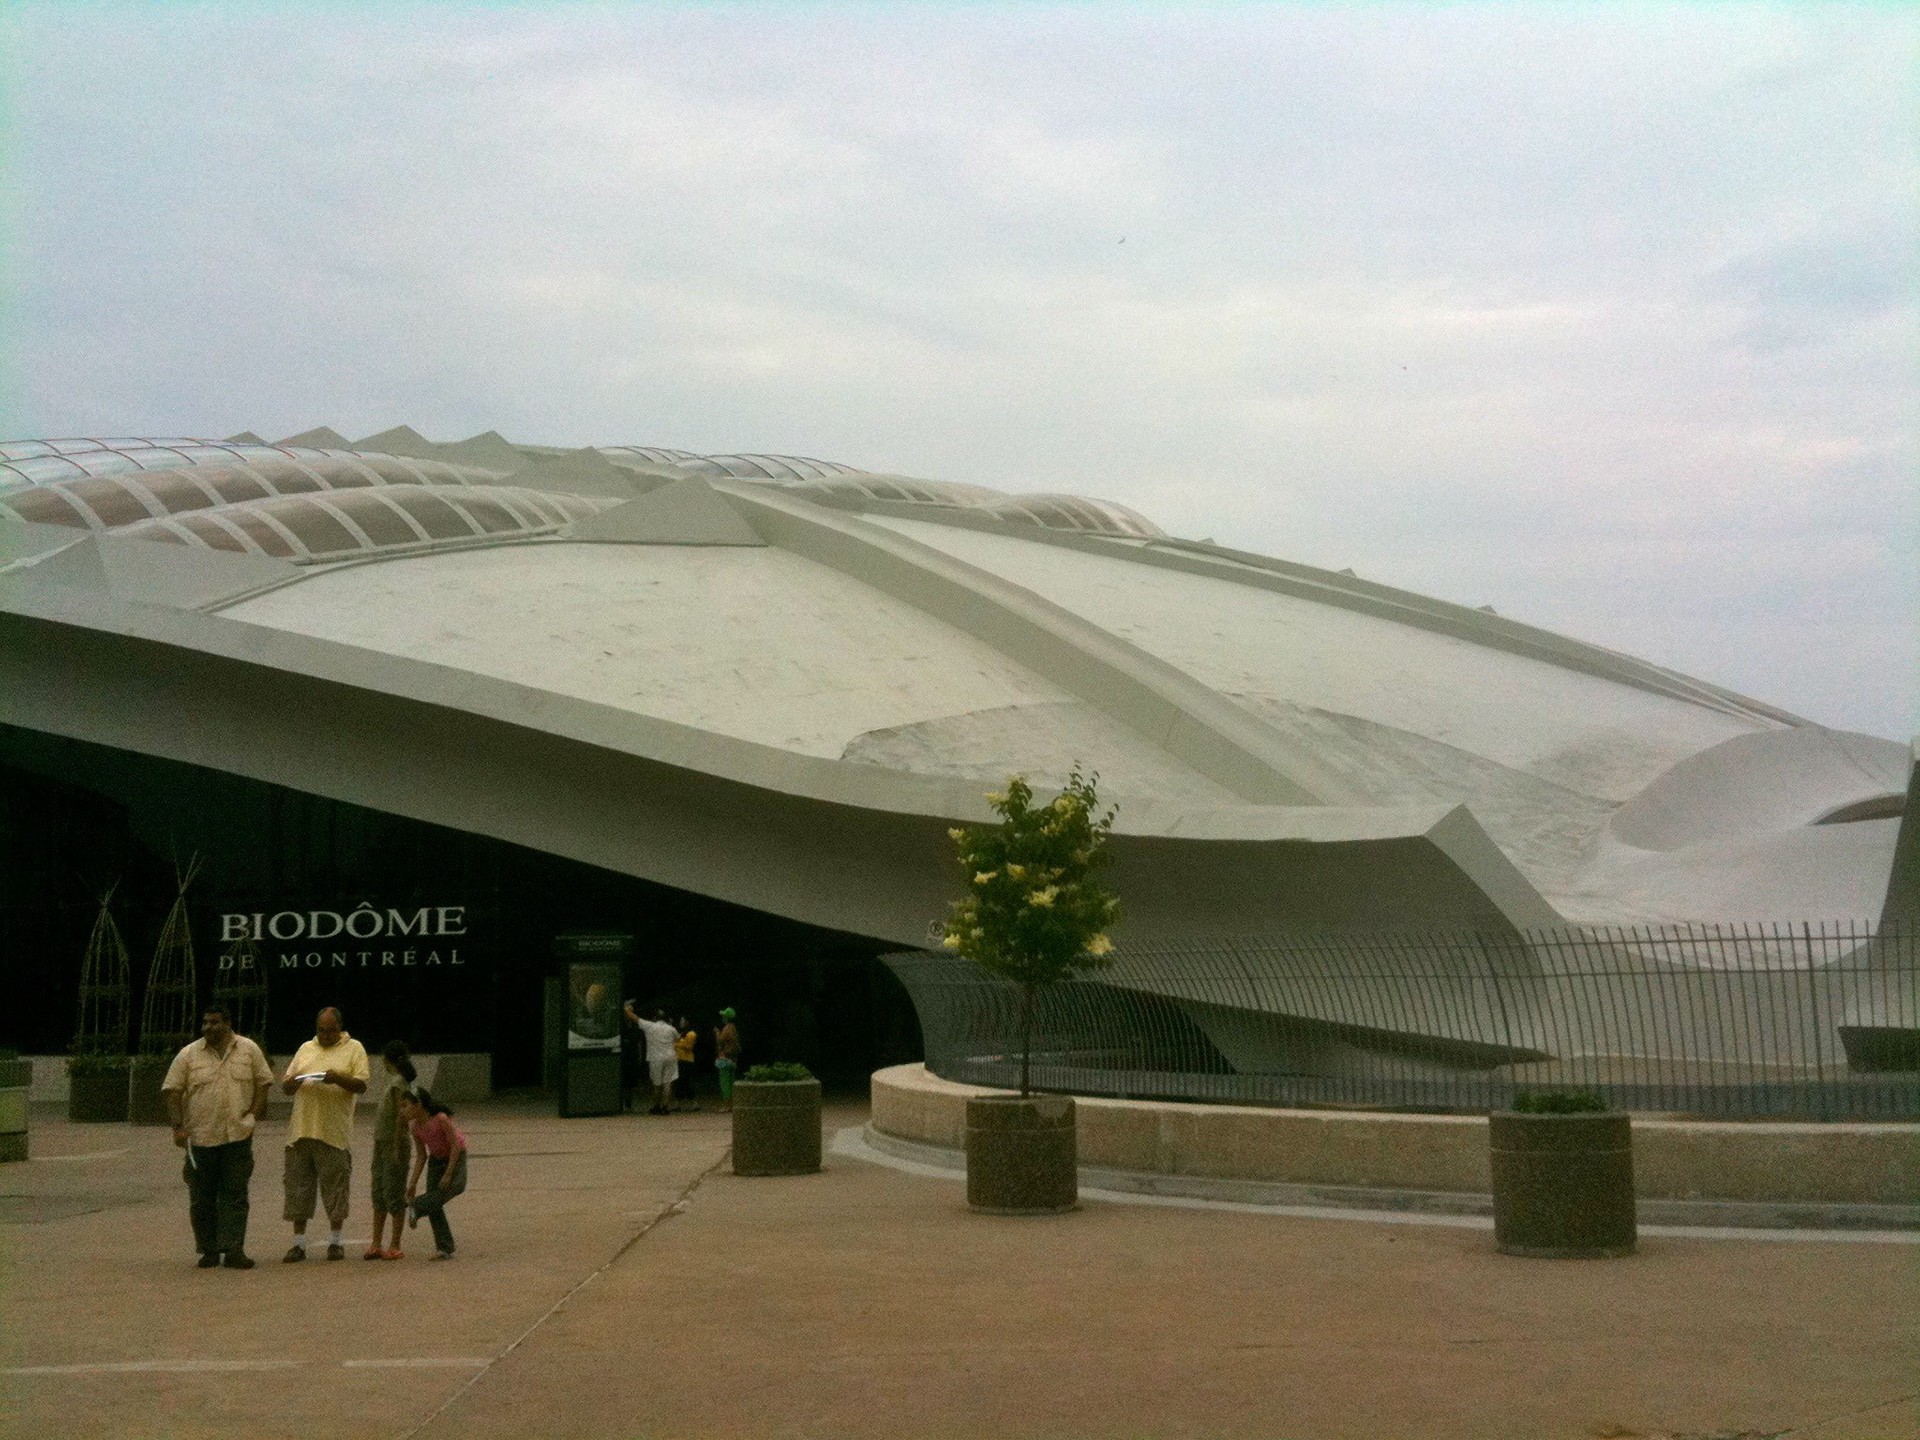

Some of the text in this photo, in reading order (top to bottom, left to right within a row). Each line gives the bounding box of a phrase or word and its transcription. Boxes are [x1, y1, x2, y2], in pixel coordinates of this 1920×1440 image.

[220, 902, 467, 941] BIODÔME
[219, 947, 465, 970] DE MONTRÉAL
